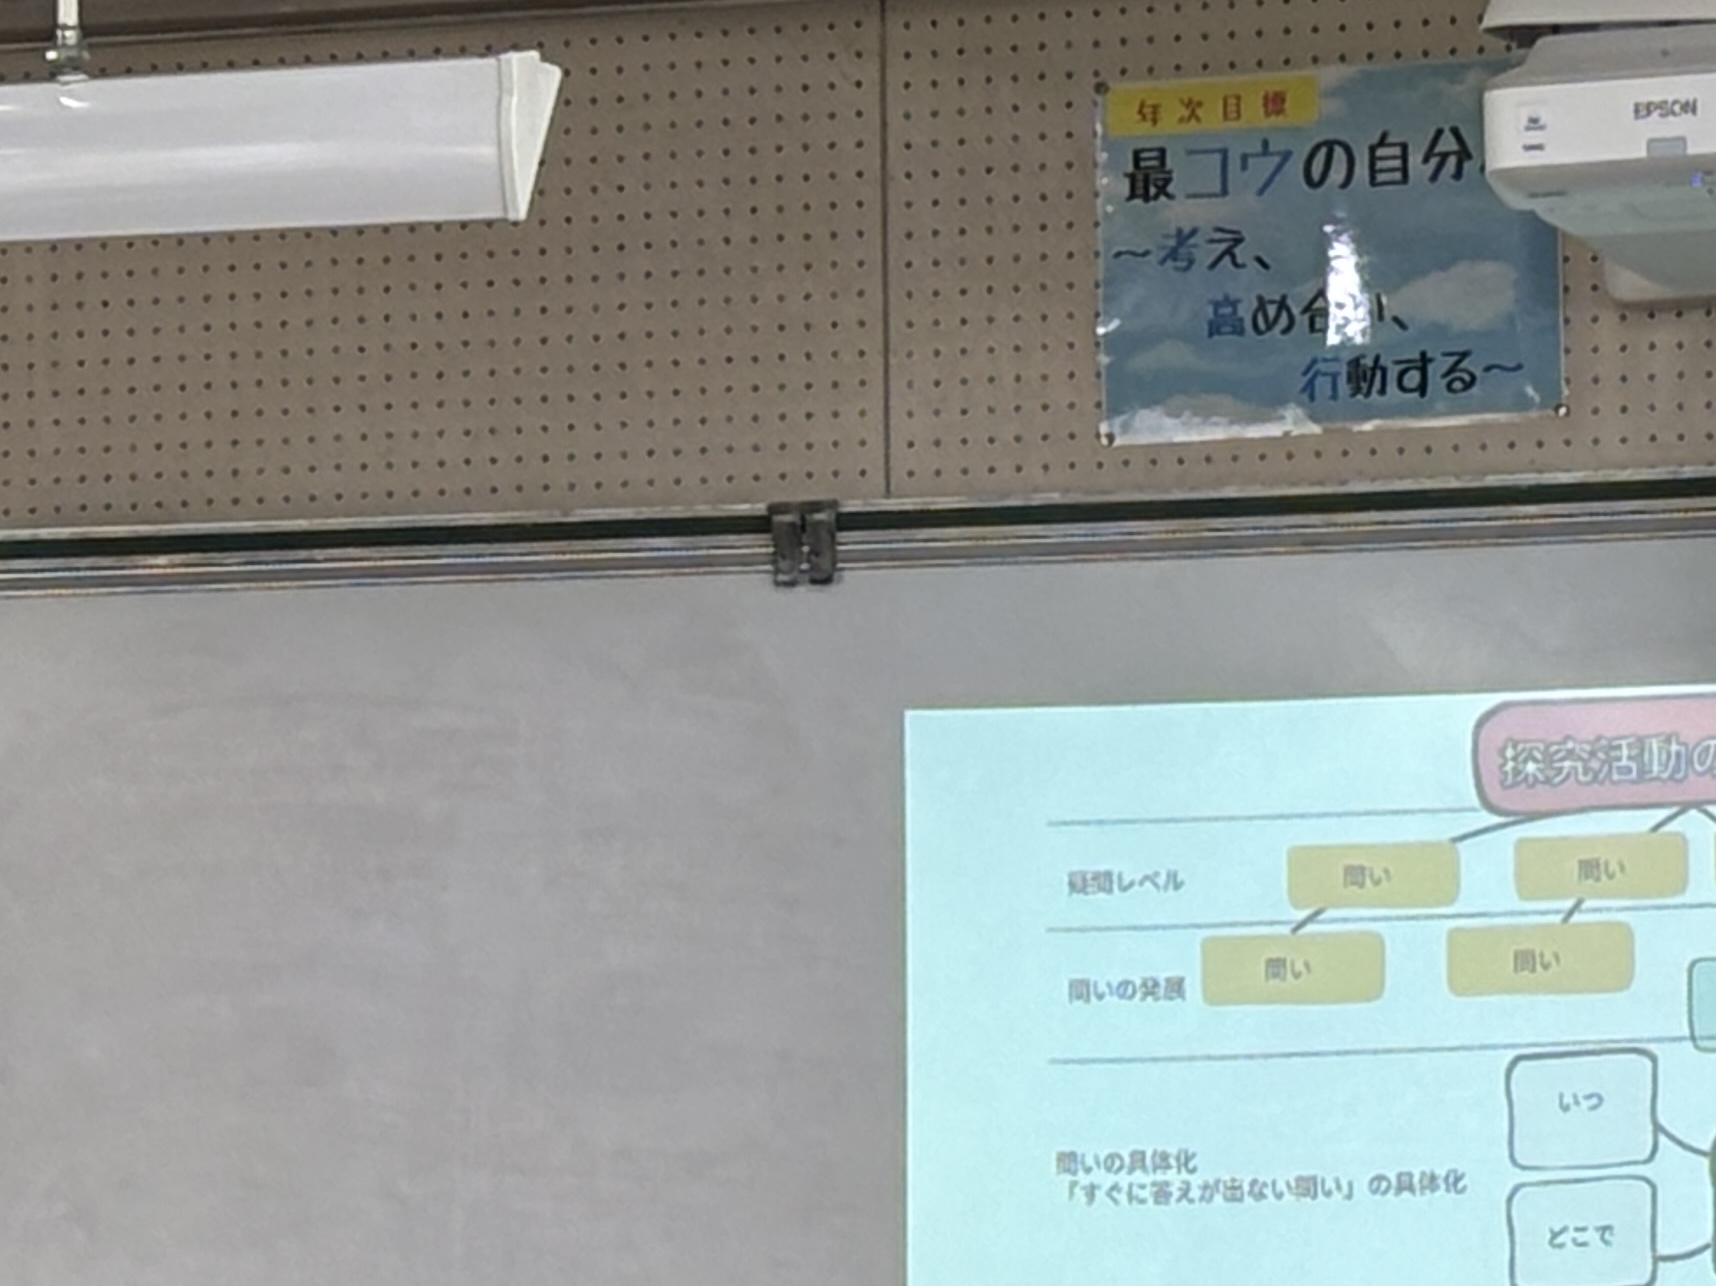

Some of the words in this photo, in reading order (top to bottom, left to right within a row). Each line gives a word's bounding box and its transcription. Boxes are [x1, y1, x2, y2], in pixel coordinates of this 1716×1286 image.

[1634, 97, 1698, 120] EPSON
[1124, 125, 1486, 203] 最コウの自分
[1067, 868, 1186, 898] 疑問レベル
[1342, 864, 1392, 890] 問い
[1577, 856, 1627, 883] 問い
[1264, 956, 1312, 983] 問い
[1512, 948, 1562, 975] 問い
[1067, 975, 1187, 1005] 問いの発展
[1556, 1090, 1605, 1114] いつ
[1055, 1147, 1199, 1178] 問いの具体化
[1546, 1224, 1616, 1251] どこで
